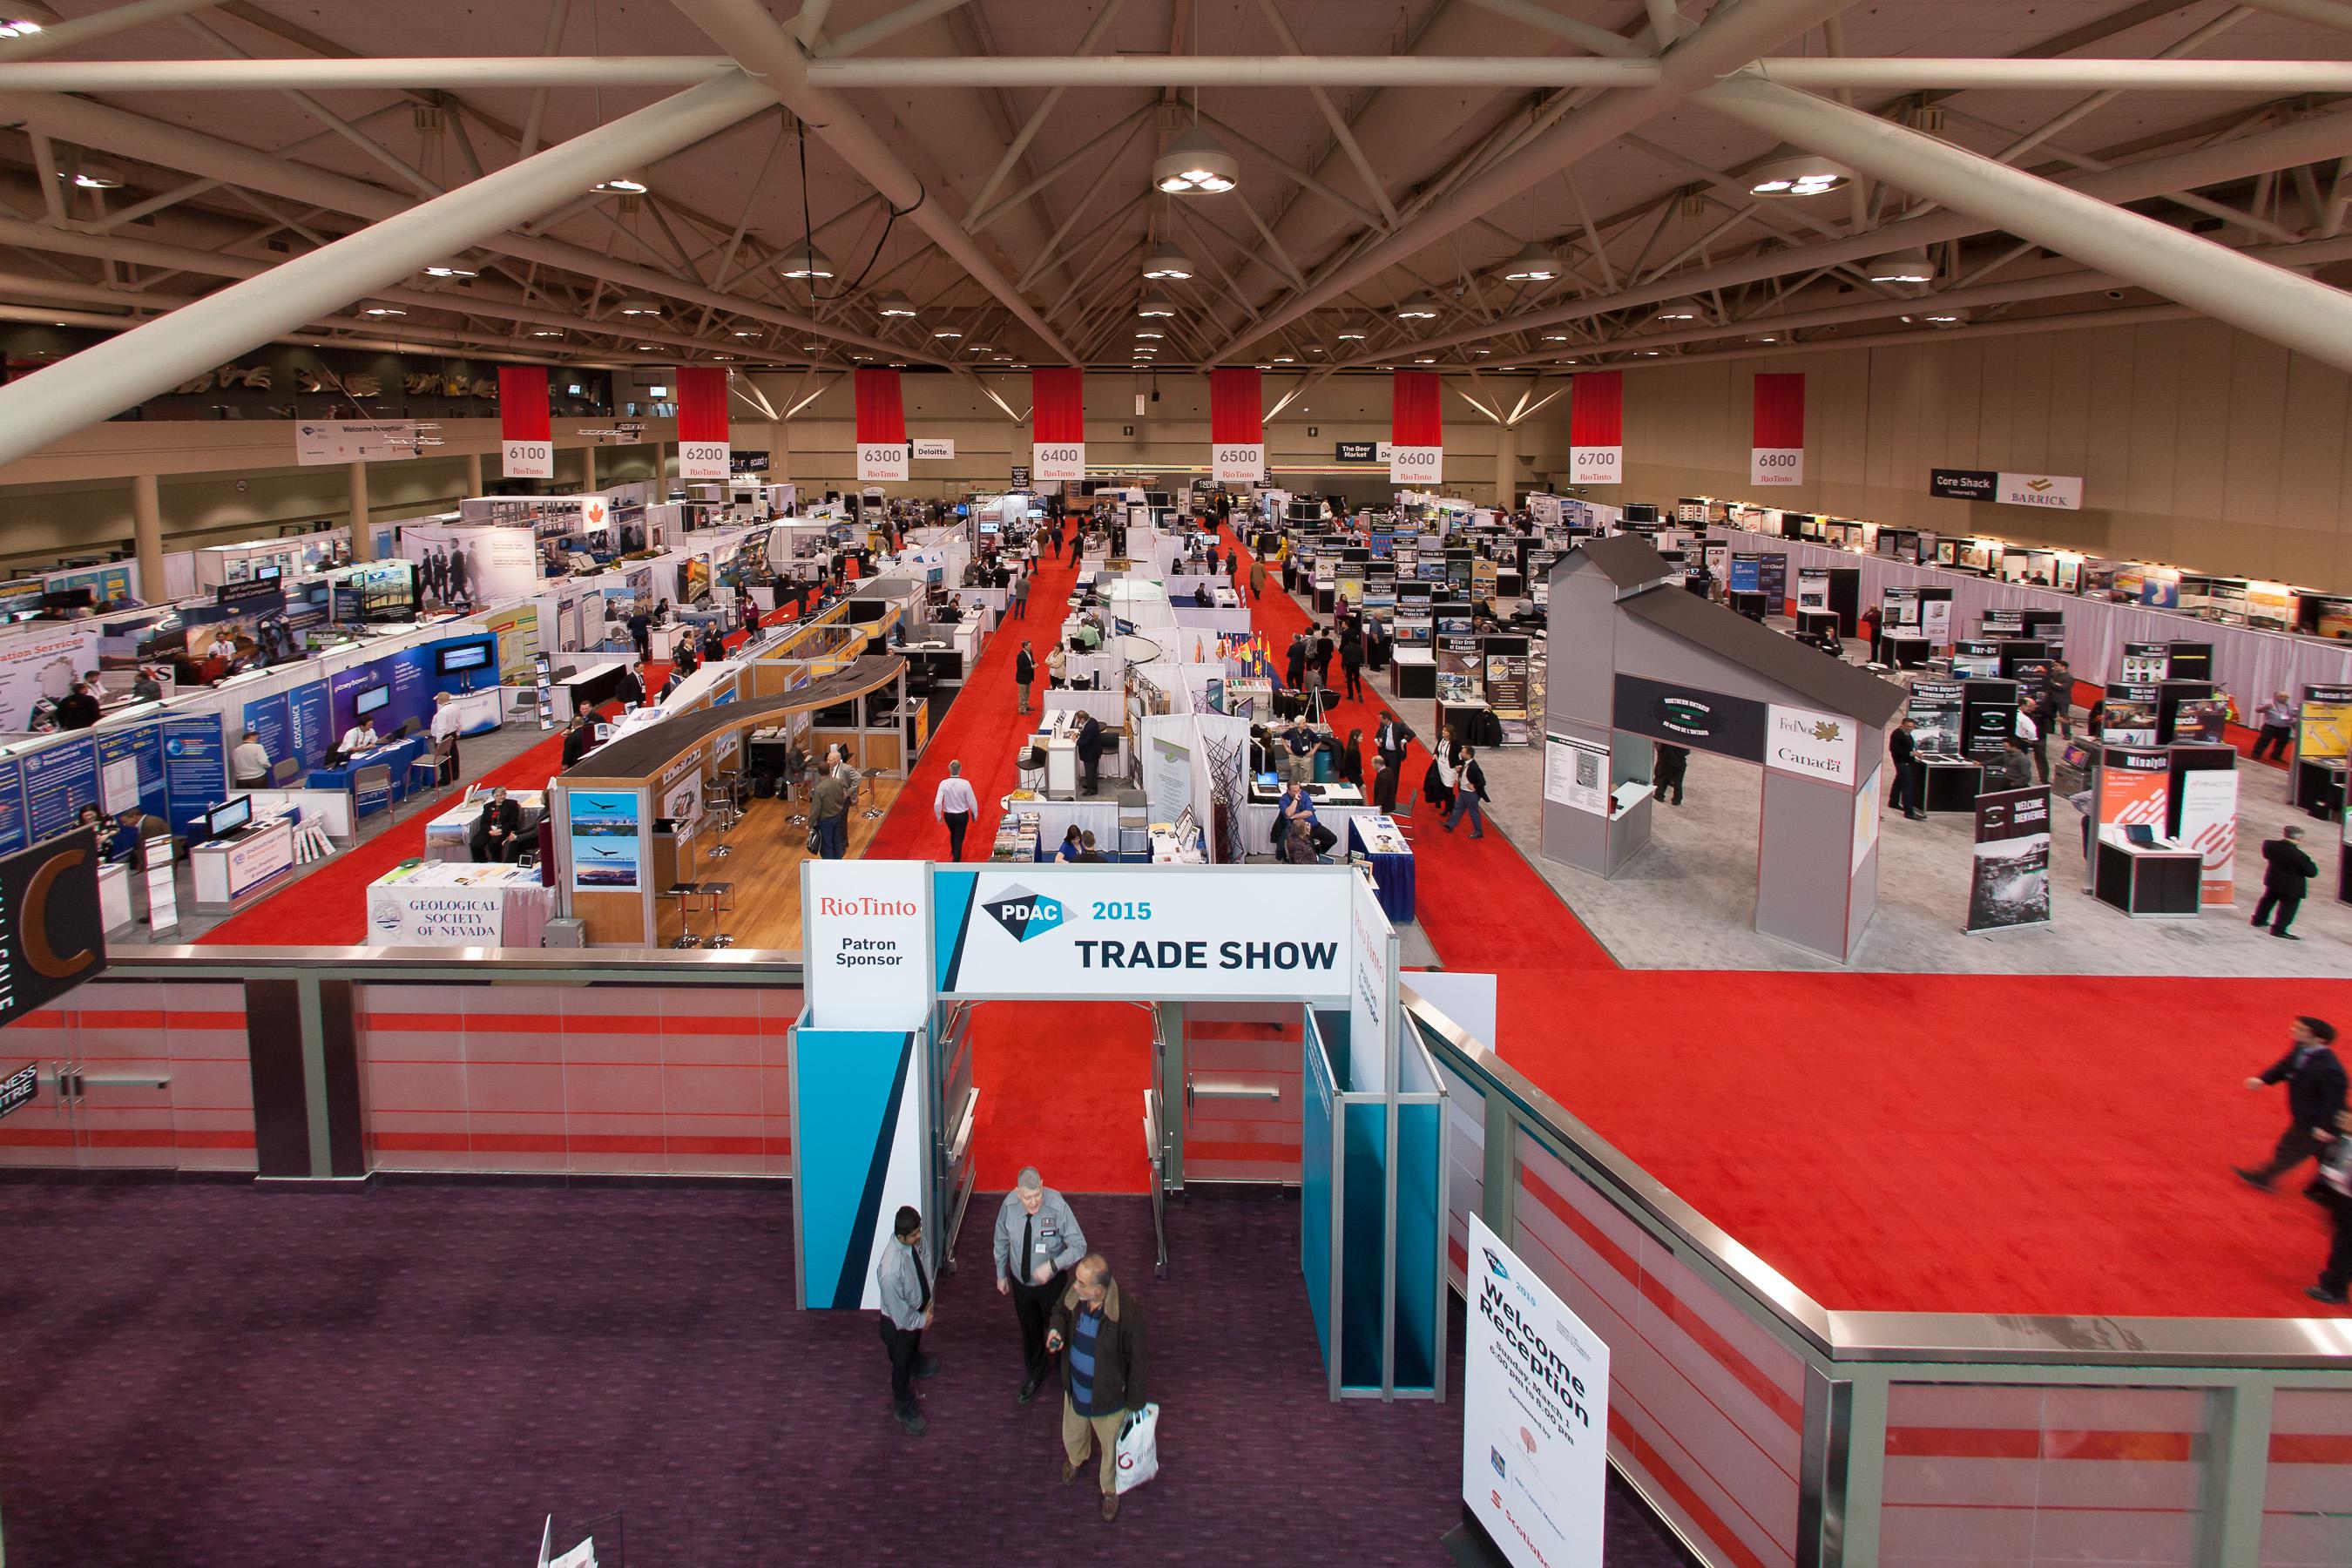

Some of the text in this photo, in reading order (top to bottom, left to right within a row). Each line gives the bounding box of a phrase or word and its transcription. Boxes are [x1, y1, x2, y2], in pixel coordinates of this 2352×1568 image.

[510, 447, 545, 459] 6100
[686, 448, 723, 460] 6200
[865, 450, 901, 462] 6300
[1041, 449, 1078, 461] 6400
[1220, 450, 1257, 462] 6500
[1398, 453, 1435, 464] 6600
[1578, 453, 1614, 465] 6700
[1759, 455, 1796, 467] 6800
[1937, 476, 1990, 489] Core Shack
[2011, 493, 2067, 505] BARRICK
[34, 636, 84, 653] Services
[294, 704, 302, 749] GEOSCIENCE
[1781, 717, 1815, 735] FedNor
[1779, 747, 1841, 773] Canada
[2014, 798, 2044, 811] WELCOME
[2014, 809, 2047, 823] BIENVENUE
[20, 849, 96, 978] C
[409, 900, 500, 911] GEOLOGICAL
[820, 896, 917, 918] RioTinto
[1001, 902, 1152, 921] PDAC 2015
[425, 914, 483, 924] SOCIETY
[418, 926, 496, 937] OF NEVADA
[841, 937, 896, 951] Patron
[1355, 909, 1385, 983] RioTinto
[835, 951, 903, 968] Sponsor
[1075, 940, 1338, 970] TRADE SHOW
[1360, 962, 1377, 1008] Patron
[1358, 974, 1379, 1027] Sponsor
[1486, 1252, 1536, 1307] PDAC 2015
[1484, 1274, 1586, 1399] Welcome
[1480, 1293, 1589, 1429] Reception
[1496, 1341, 1531, 1385] Sunday,
[1532, 1382, 1564, 1421] March
[1490, 1345, 1574, 1446] 6:00 pm to 8:00 pm
